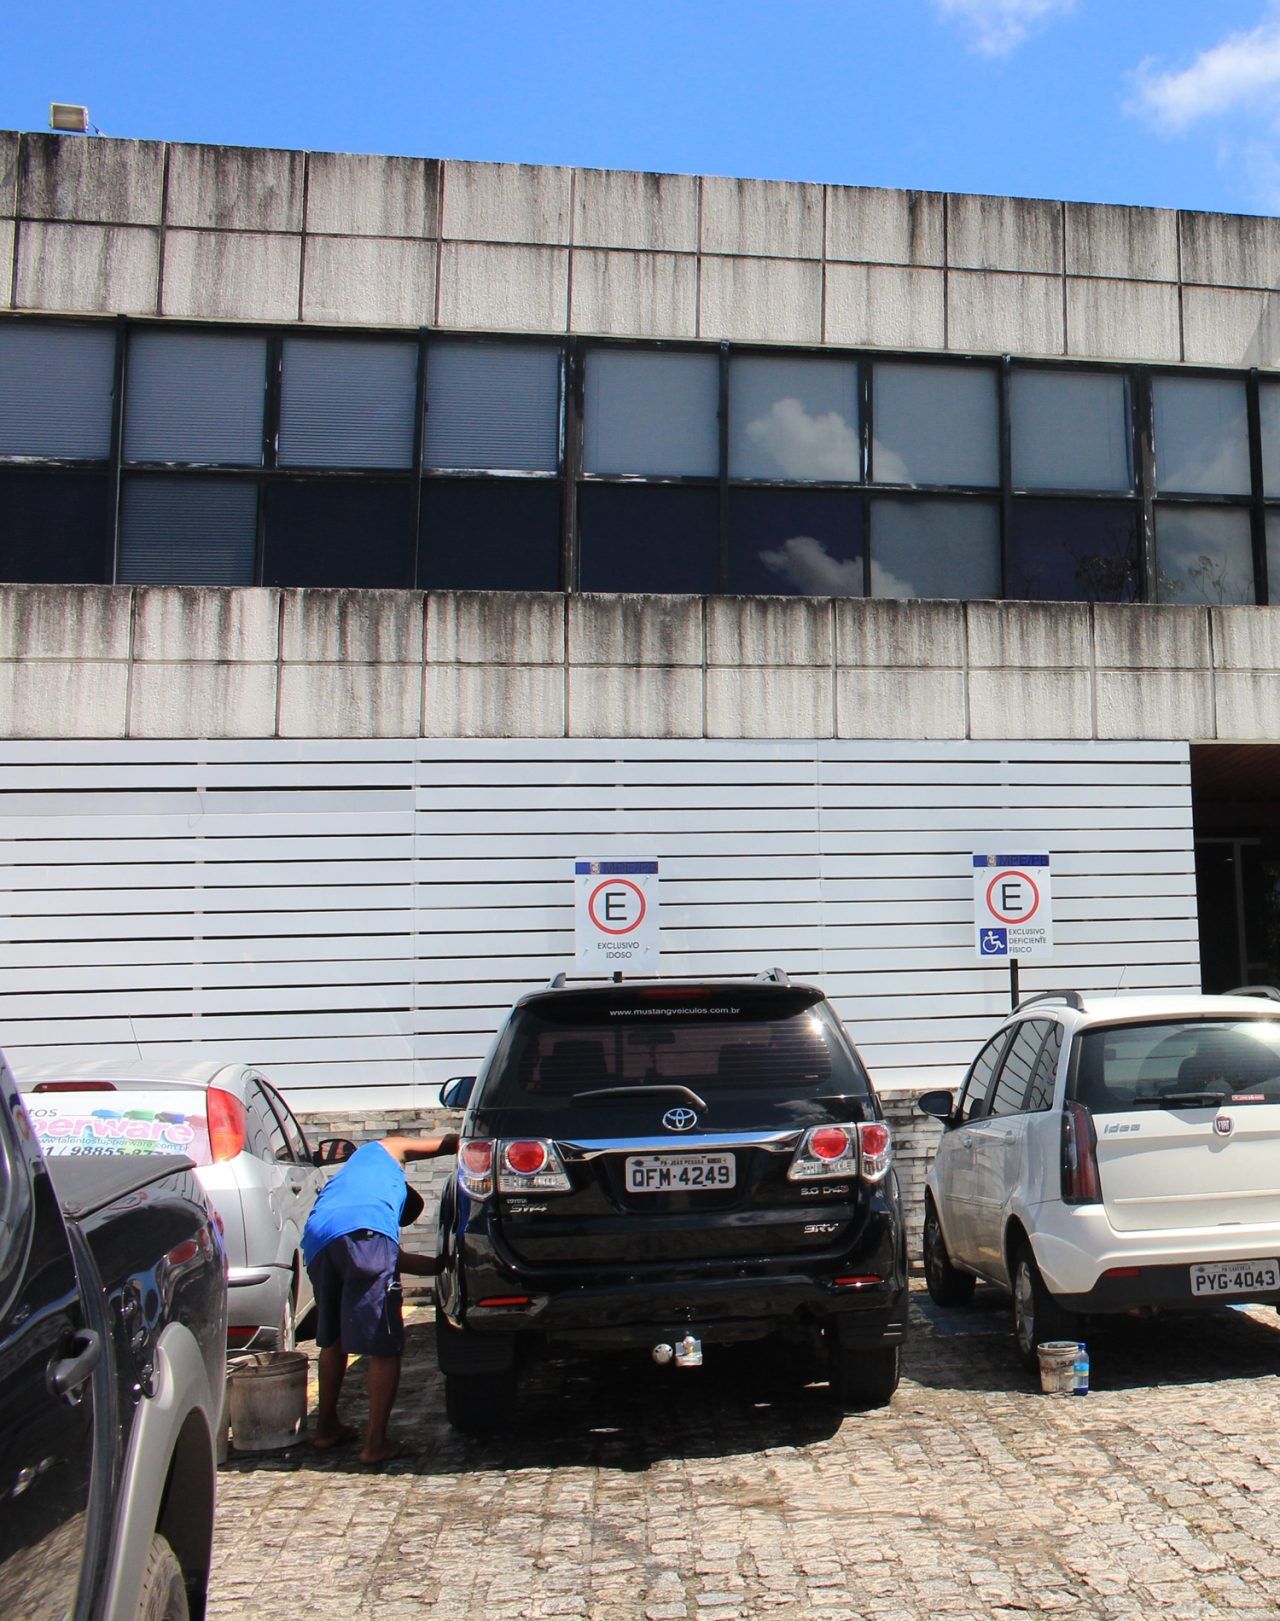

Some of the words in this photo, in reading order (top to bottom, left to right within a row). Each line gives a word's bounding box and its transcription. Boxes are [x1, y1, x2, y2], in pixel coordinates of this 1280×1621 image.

[1002, 883, 1023, 911] E
[605, 892, 627, 921] E
[597, 942, 640, 950] EXCLUSIVO
[606, 951, 632, 959] IDOSO
[609, 1007, 740, 1016] www.mustangveiculos.com.br
